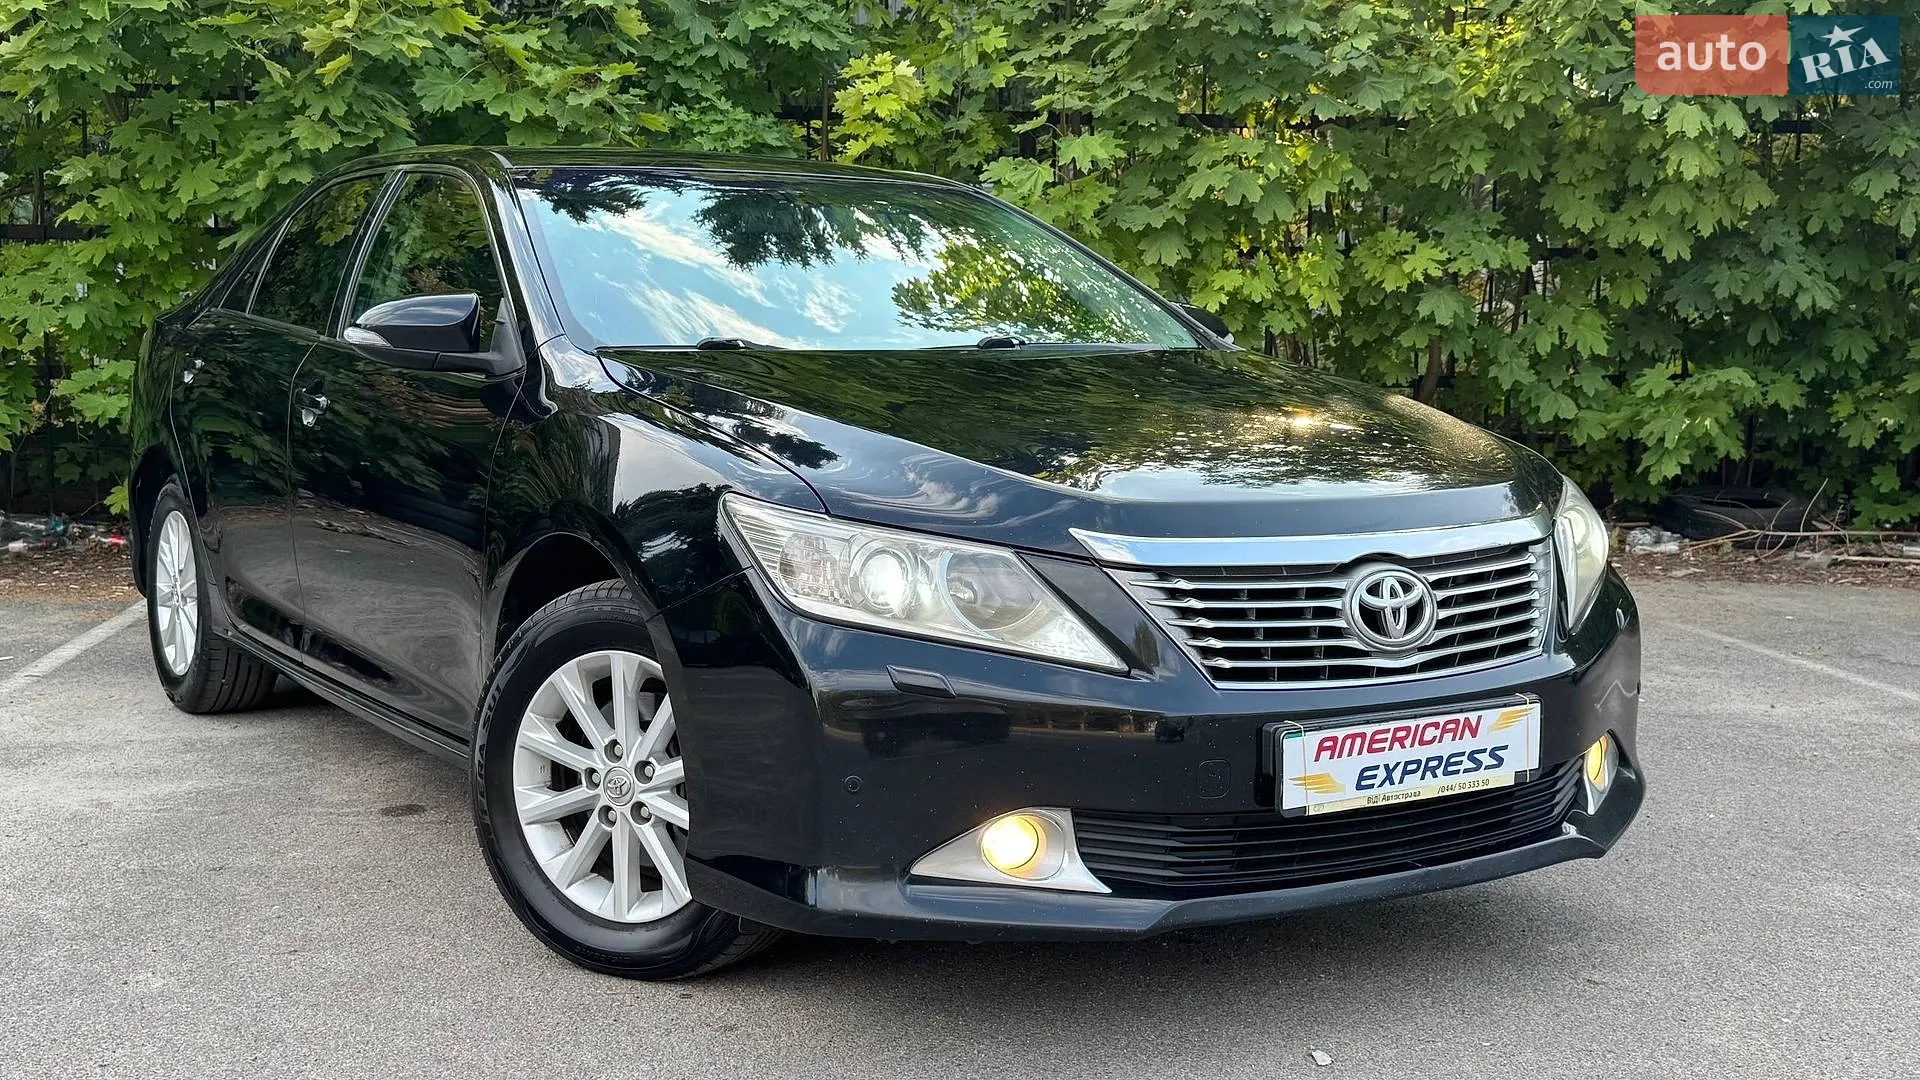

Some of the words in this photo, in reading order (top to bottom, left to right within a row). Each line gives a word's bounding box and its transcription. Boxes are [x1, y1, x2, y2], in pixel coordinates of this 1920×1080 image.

[1313, 715, 1483, 762] AMERICAN
[1355, 745, 1509, 791] EXPRESS
[1458, 782, 1467, 790] 50
[1467, 780, 1480, 789] 333
[1481, 778, 1490, 787] 50
